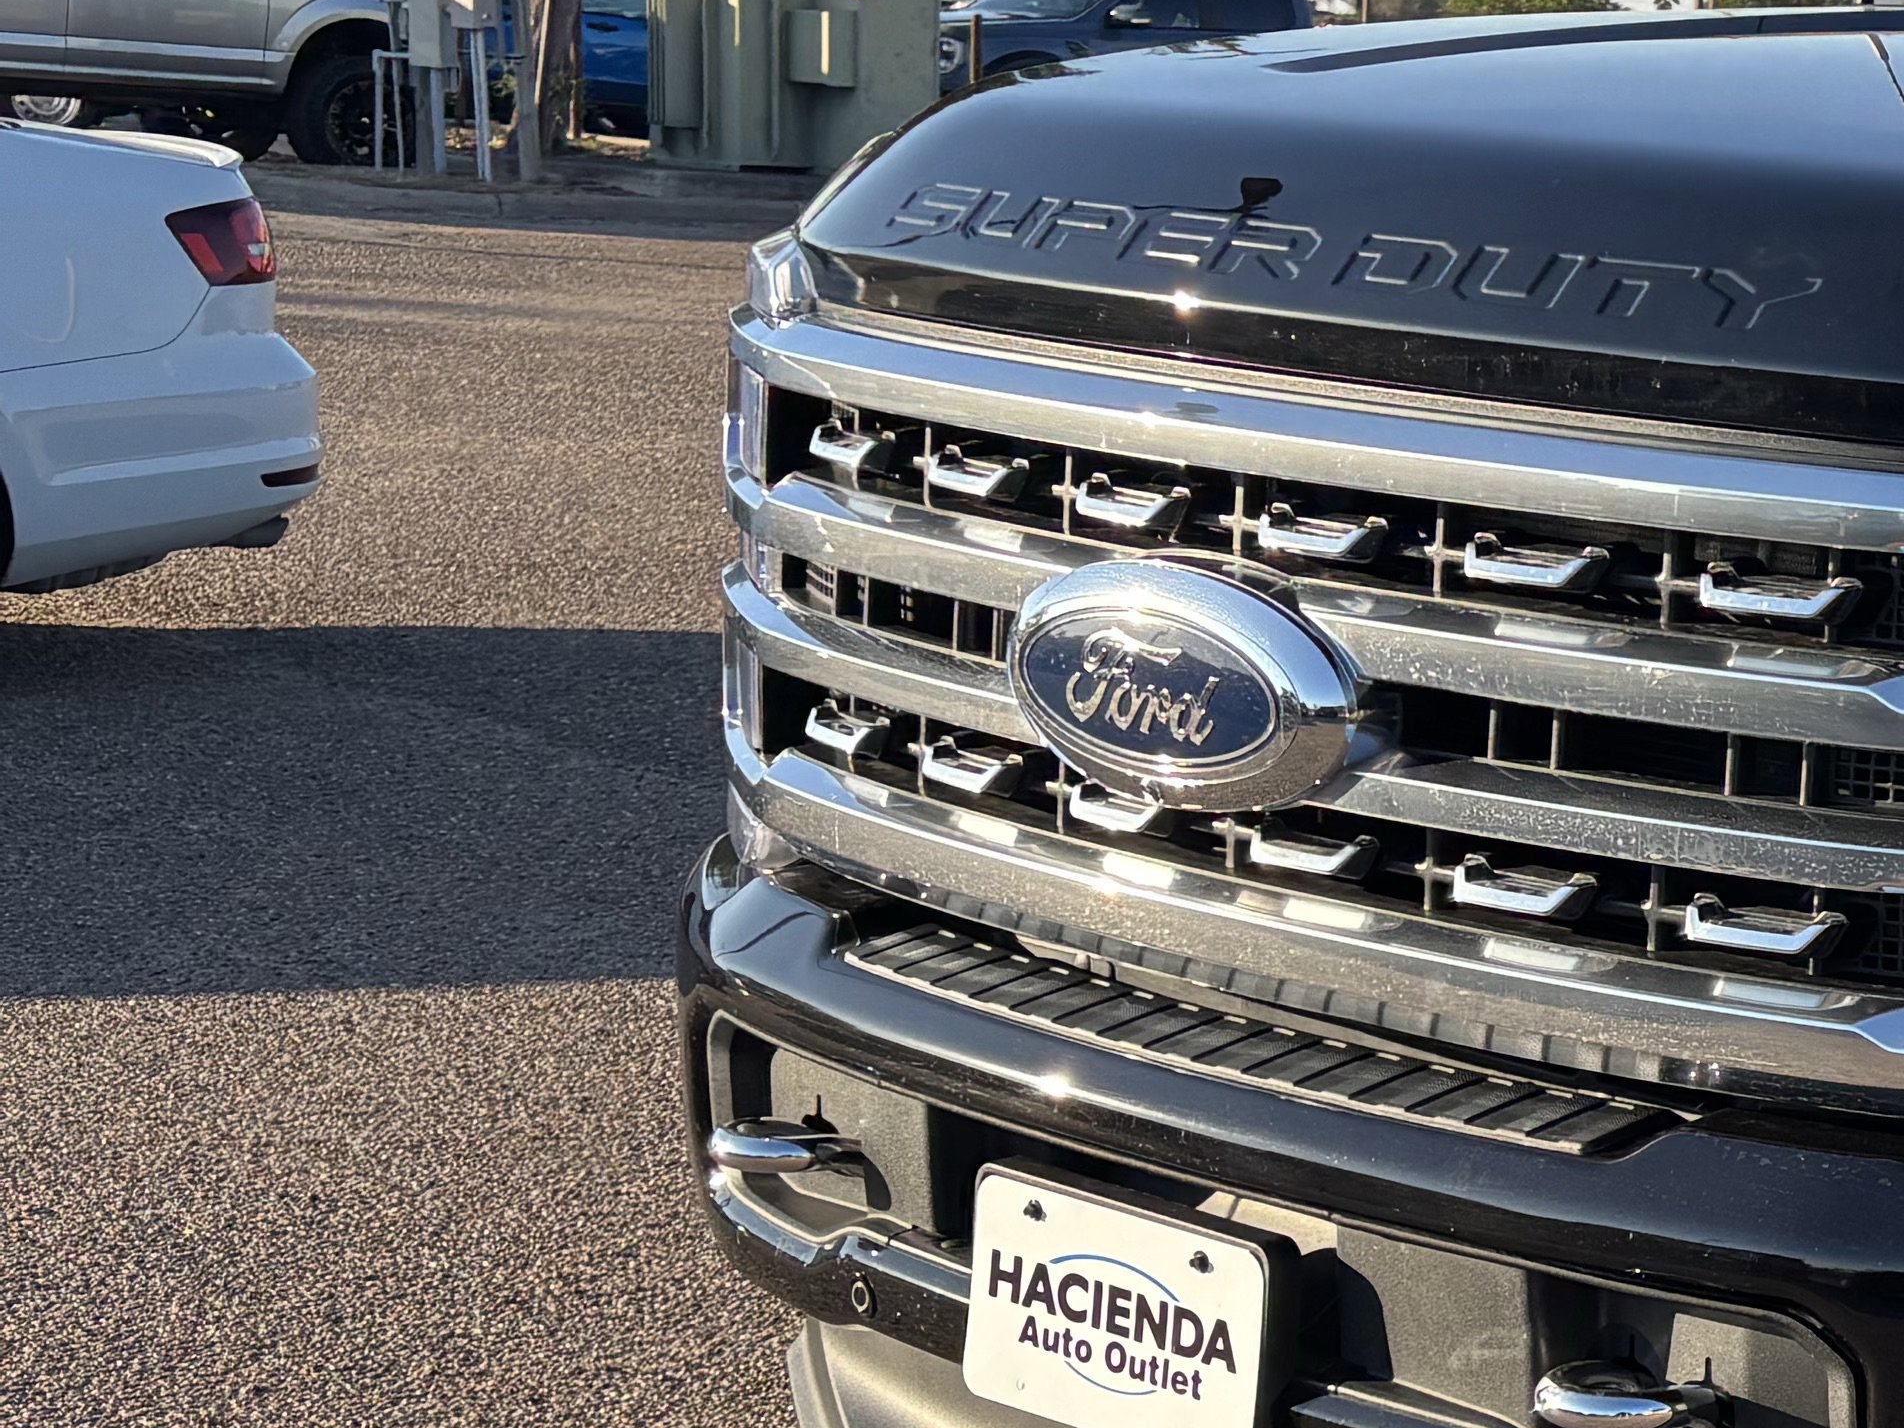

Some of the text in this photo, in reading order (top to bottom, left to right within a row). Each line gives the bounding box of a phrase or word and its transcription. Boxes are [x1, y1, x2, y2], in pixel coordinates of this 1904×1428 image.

[887, 180, 1825, 331] SUPER DUTY
[1064, 626, 1220, 747] Ford
[988, 1248, 1237, 1375] HACIENDA
[1018, 1315, 1202, 1401] Auto Outlet
